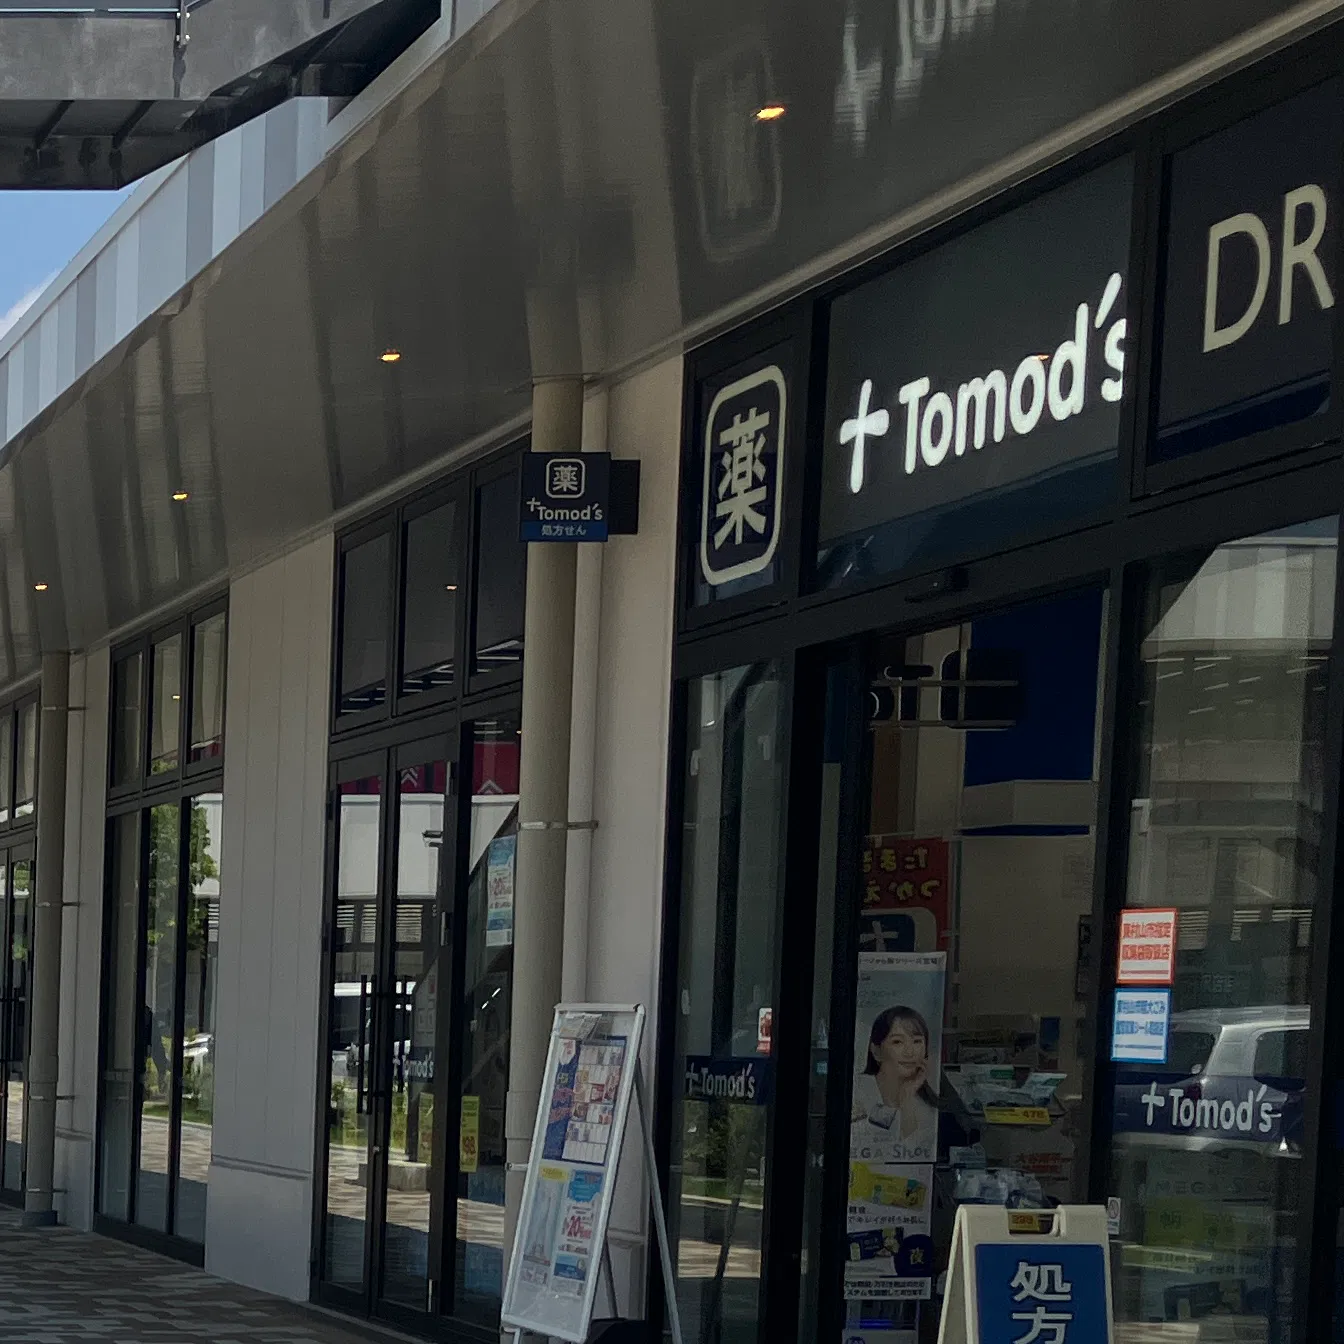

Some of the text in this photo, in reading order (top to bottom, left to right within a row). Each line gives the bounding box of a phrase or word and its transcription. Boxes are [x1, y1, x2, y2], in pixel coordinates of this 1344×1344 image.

[1203, 183, 1335, 354] DR
[898, 272, 1127, 475] Tomod's
[551, 465, 579, 492] 薬
[714, 406, 771, 551] 薬
[537, 503, 603, 521] Tomod's
[541, 524, 587, 537] 処方せん
[700, 1062, 756, 1099] Tomod's
[1168, 1083, 1273, 1133] Tomod's
